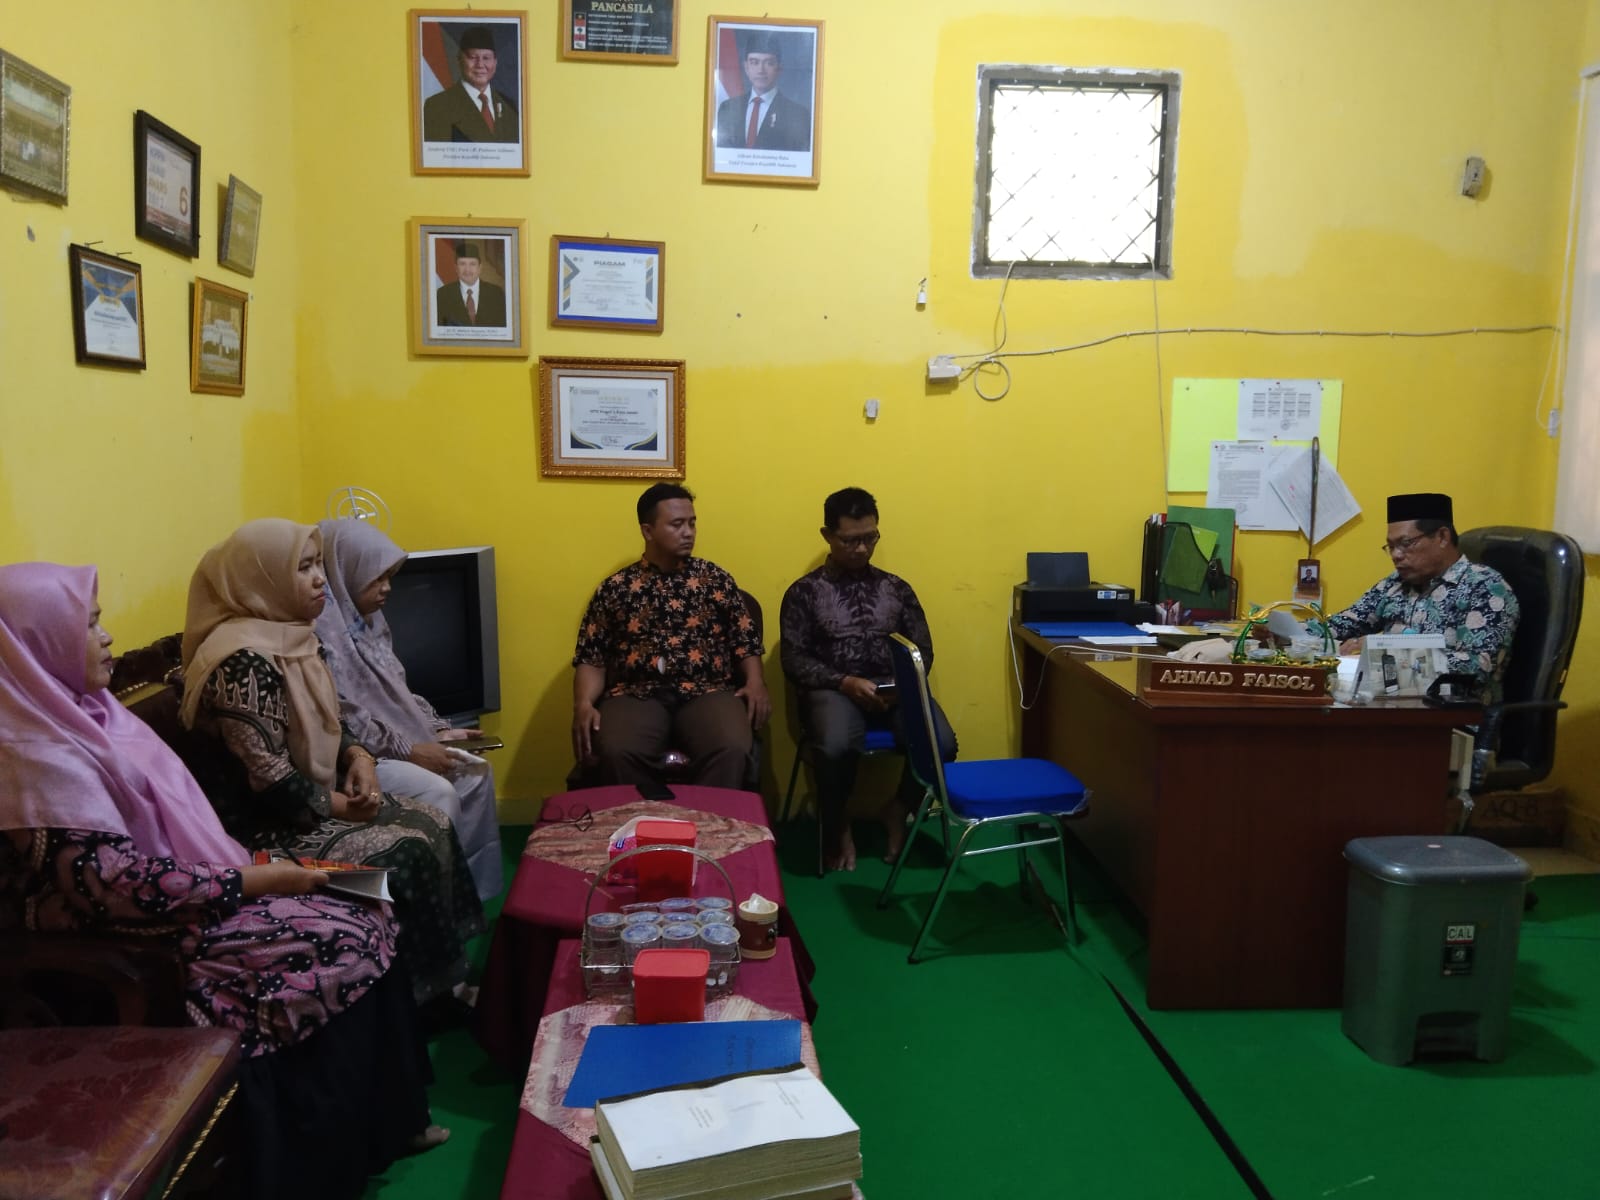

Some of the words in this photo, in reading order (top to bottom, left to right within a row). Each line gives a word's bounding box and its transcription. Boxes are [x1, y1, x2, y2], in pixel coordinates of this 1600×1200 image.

[592, 2, 653, 13] PANCASILA
[179, 186, 188, 217] 6
[1160, 669, 1234, 686] AHMAD
[1242, 673, 1315, 691] FAISOL
[1448, 928, 1472, 939] CAL
